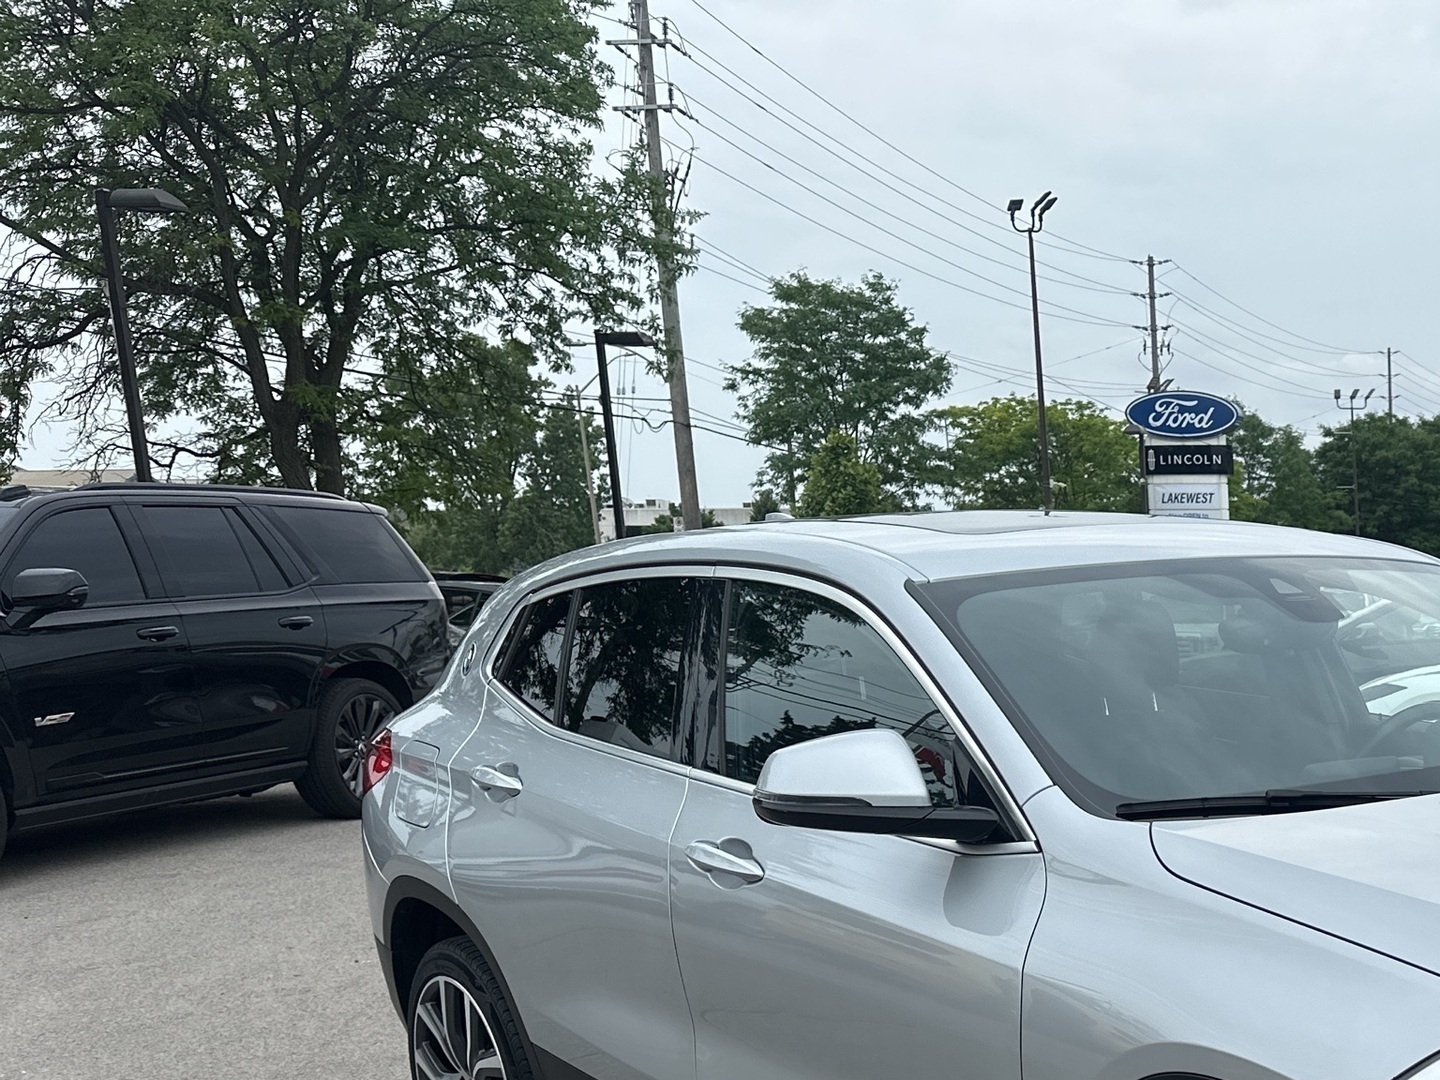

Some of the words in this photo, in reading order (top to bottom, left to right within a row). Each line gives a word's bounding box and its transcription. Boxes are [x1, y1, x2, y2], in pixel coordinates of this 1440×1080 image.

[1149, 398, 1215, 429] Ford
[1160, 454, 1222, 465] LINCOLN
[1161, 493, 1215, 504] LAKEWEST
